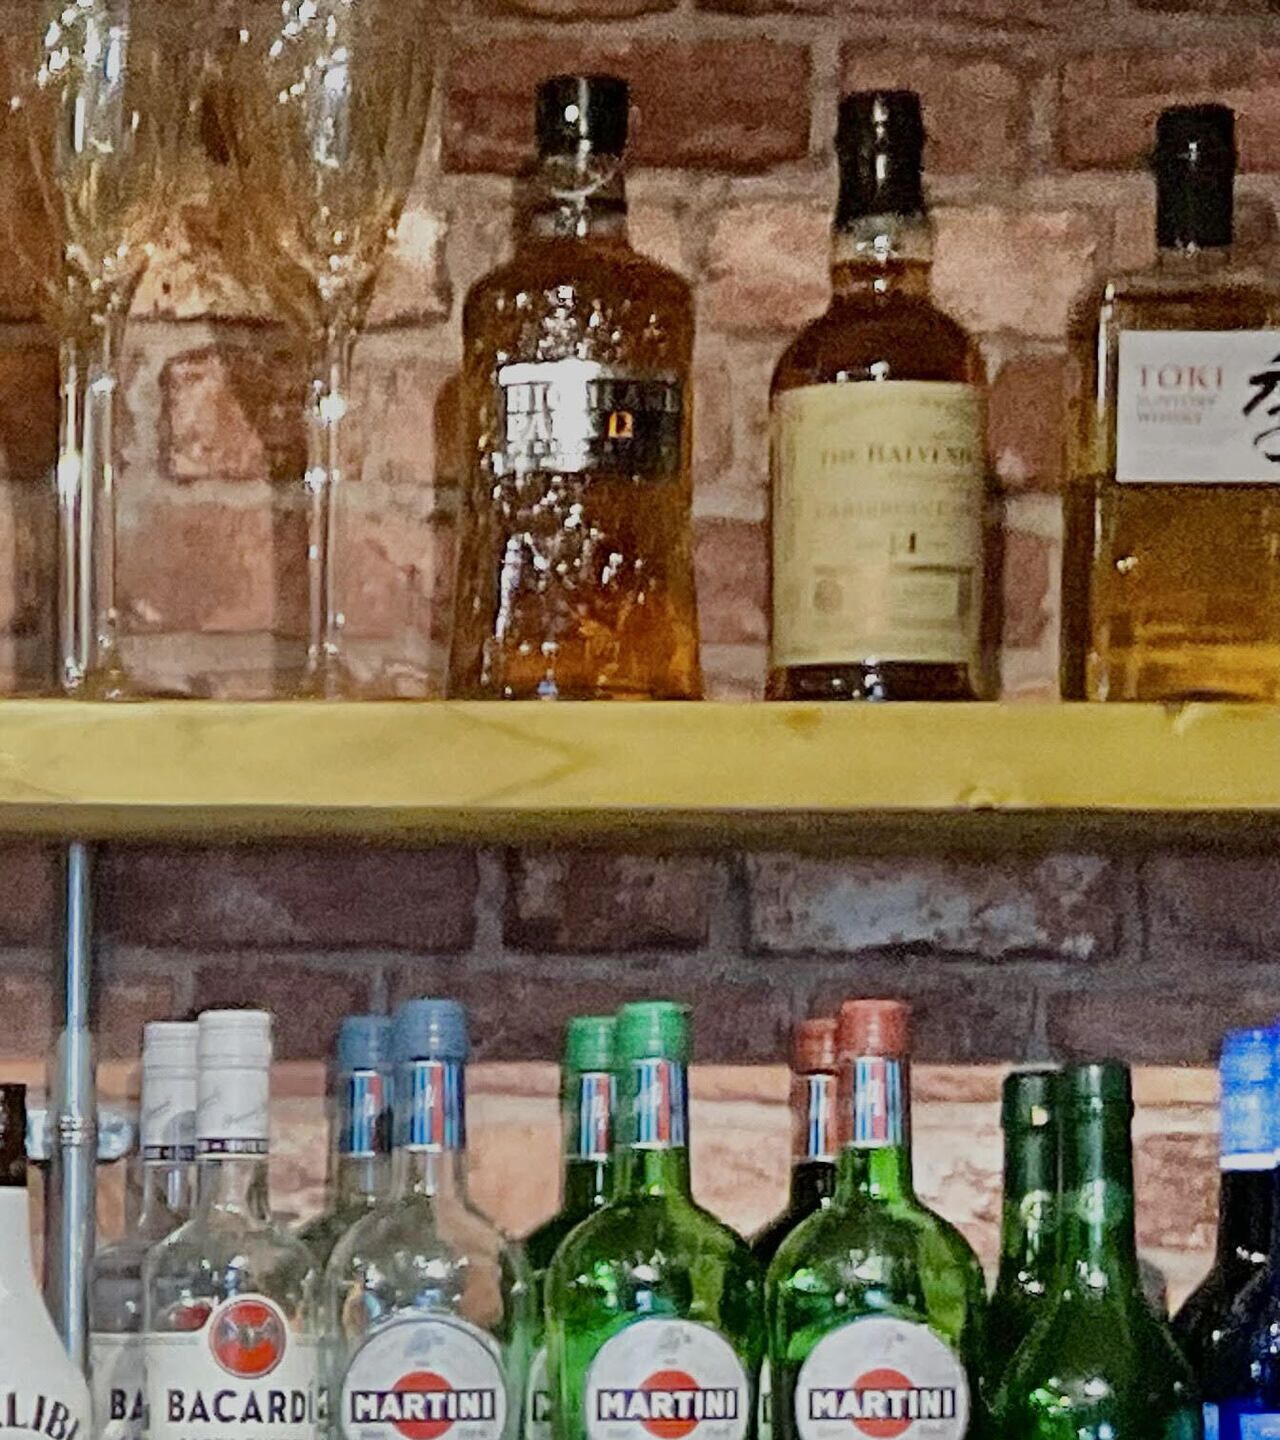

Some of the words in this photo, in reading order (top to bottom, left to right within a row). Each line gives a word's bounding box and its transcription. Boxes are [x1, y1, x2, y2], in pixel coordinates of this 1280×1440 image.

[1137, 365, 1224, 390] TOKI
[353, 1391, 494, 1421] MARTINI
[599, 1390, 736, 1420] MARTINI
[810, 1389, 954, 1419] MARTINI
